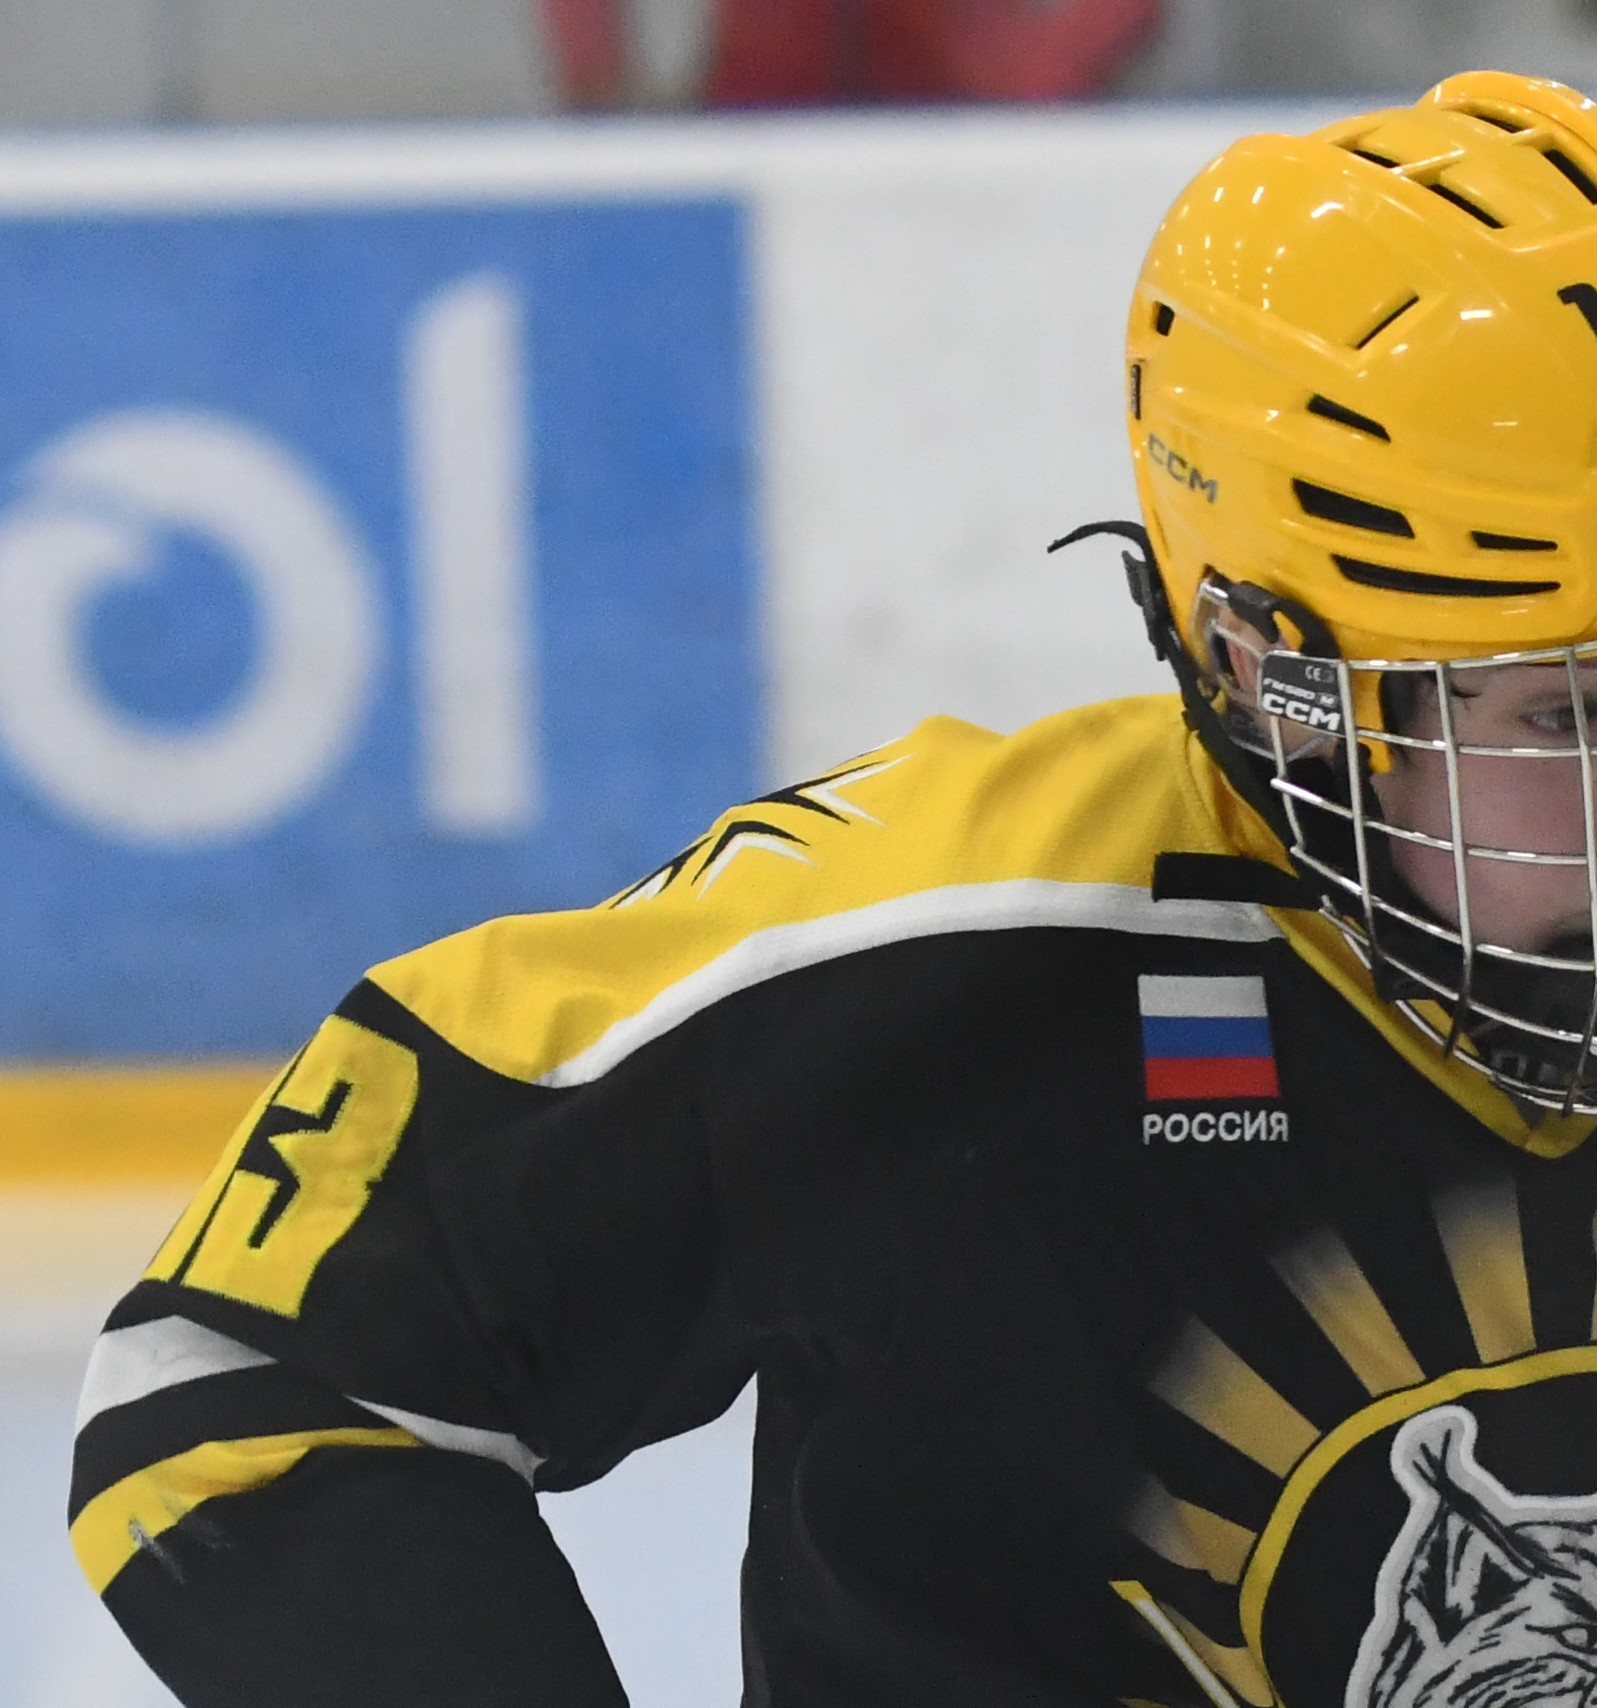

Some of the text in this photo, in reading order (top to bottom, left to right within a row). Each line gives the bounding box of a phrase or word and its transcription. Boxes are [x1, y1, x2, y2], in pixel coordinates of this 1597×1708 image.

[1147, 431, 1219, 505] CCM
[1262, 692, 1342, 731] CCM
[1141, 1109, 1291, 1146] РОССИЯ
